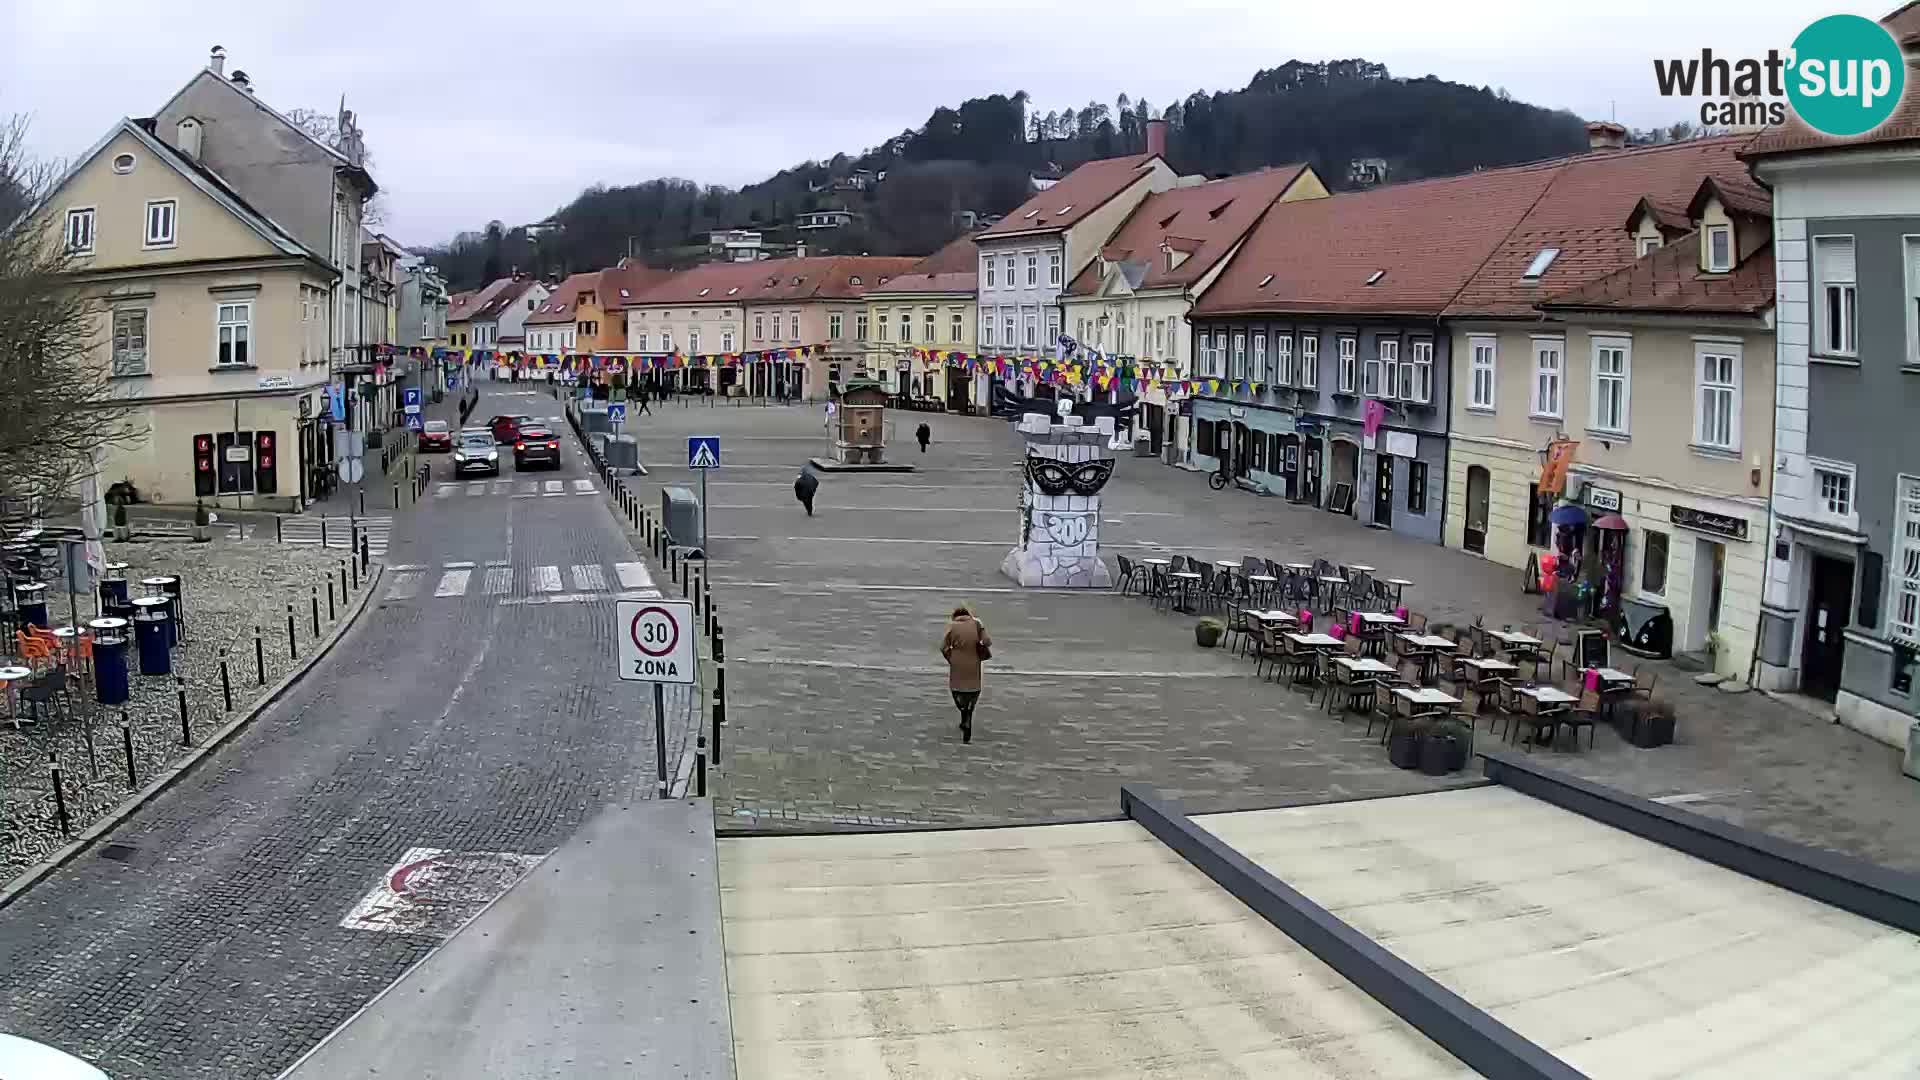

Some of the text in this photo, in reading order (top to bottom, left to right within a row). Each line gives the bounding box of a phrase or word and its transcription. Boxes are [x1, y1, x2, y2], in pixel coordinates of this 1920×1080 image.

[408, 391, 416, 403] P
[644, 622, 668, 643] 30
[633, 659, 679, 676] ZONA
